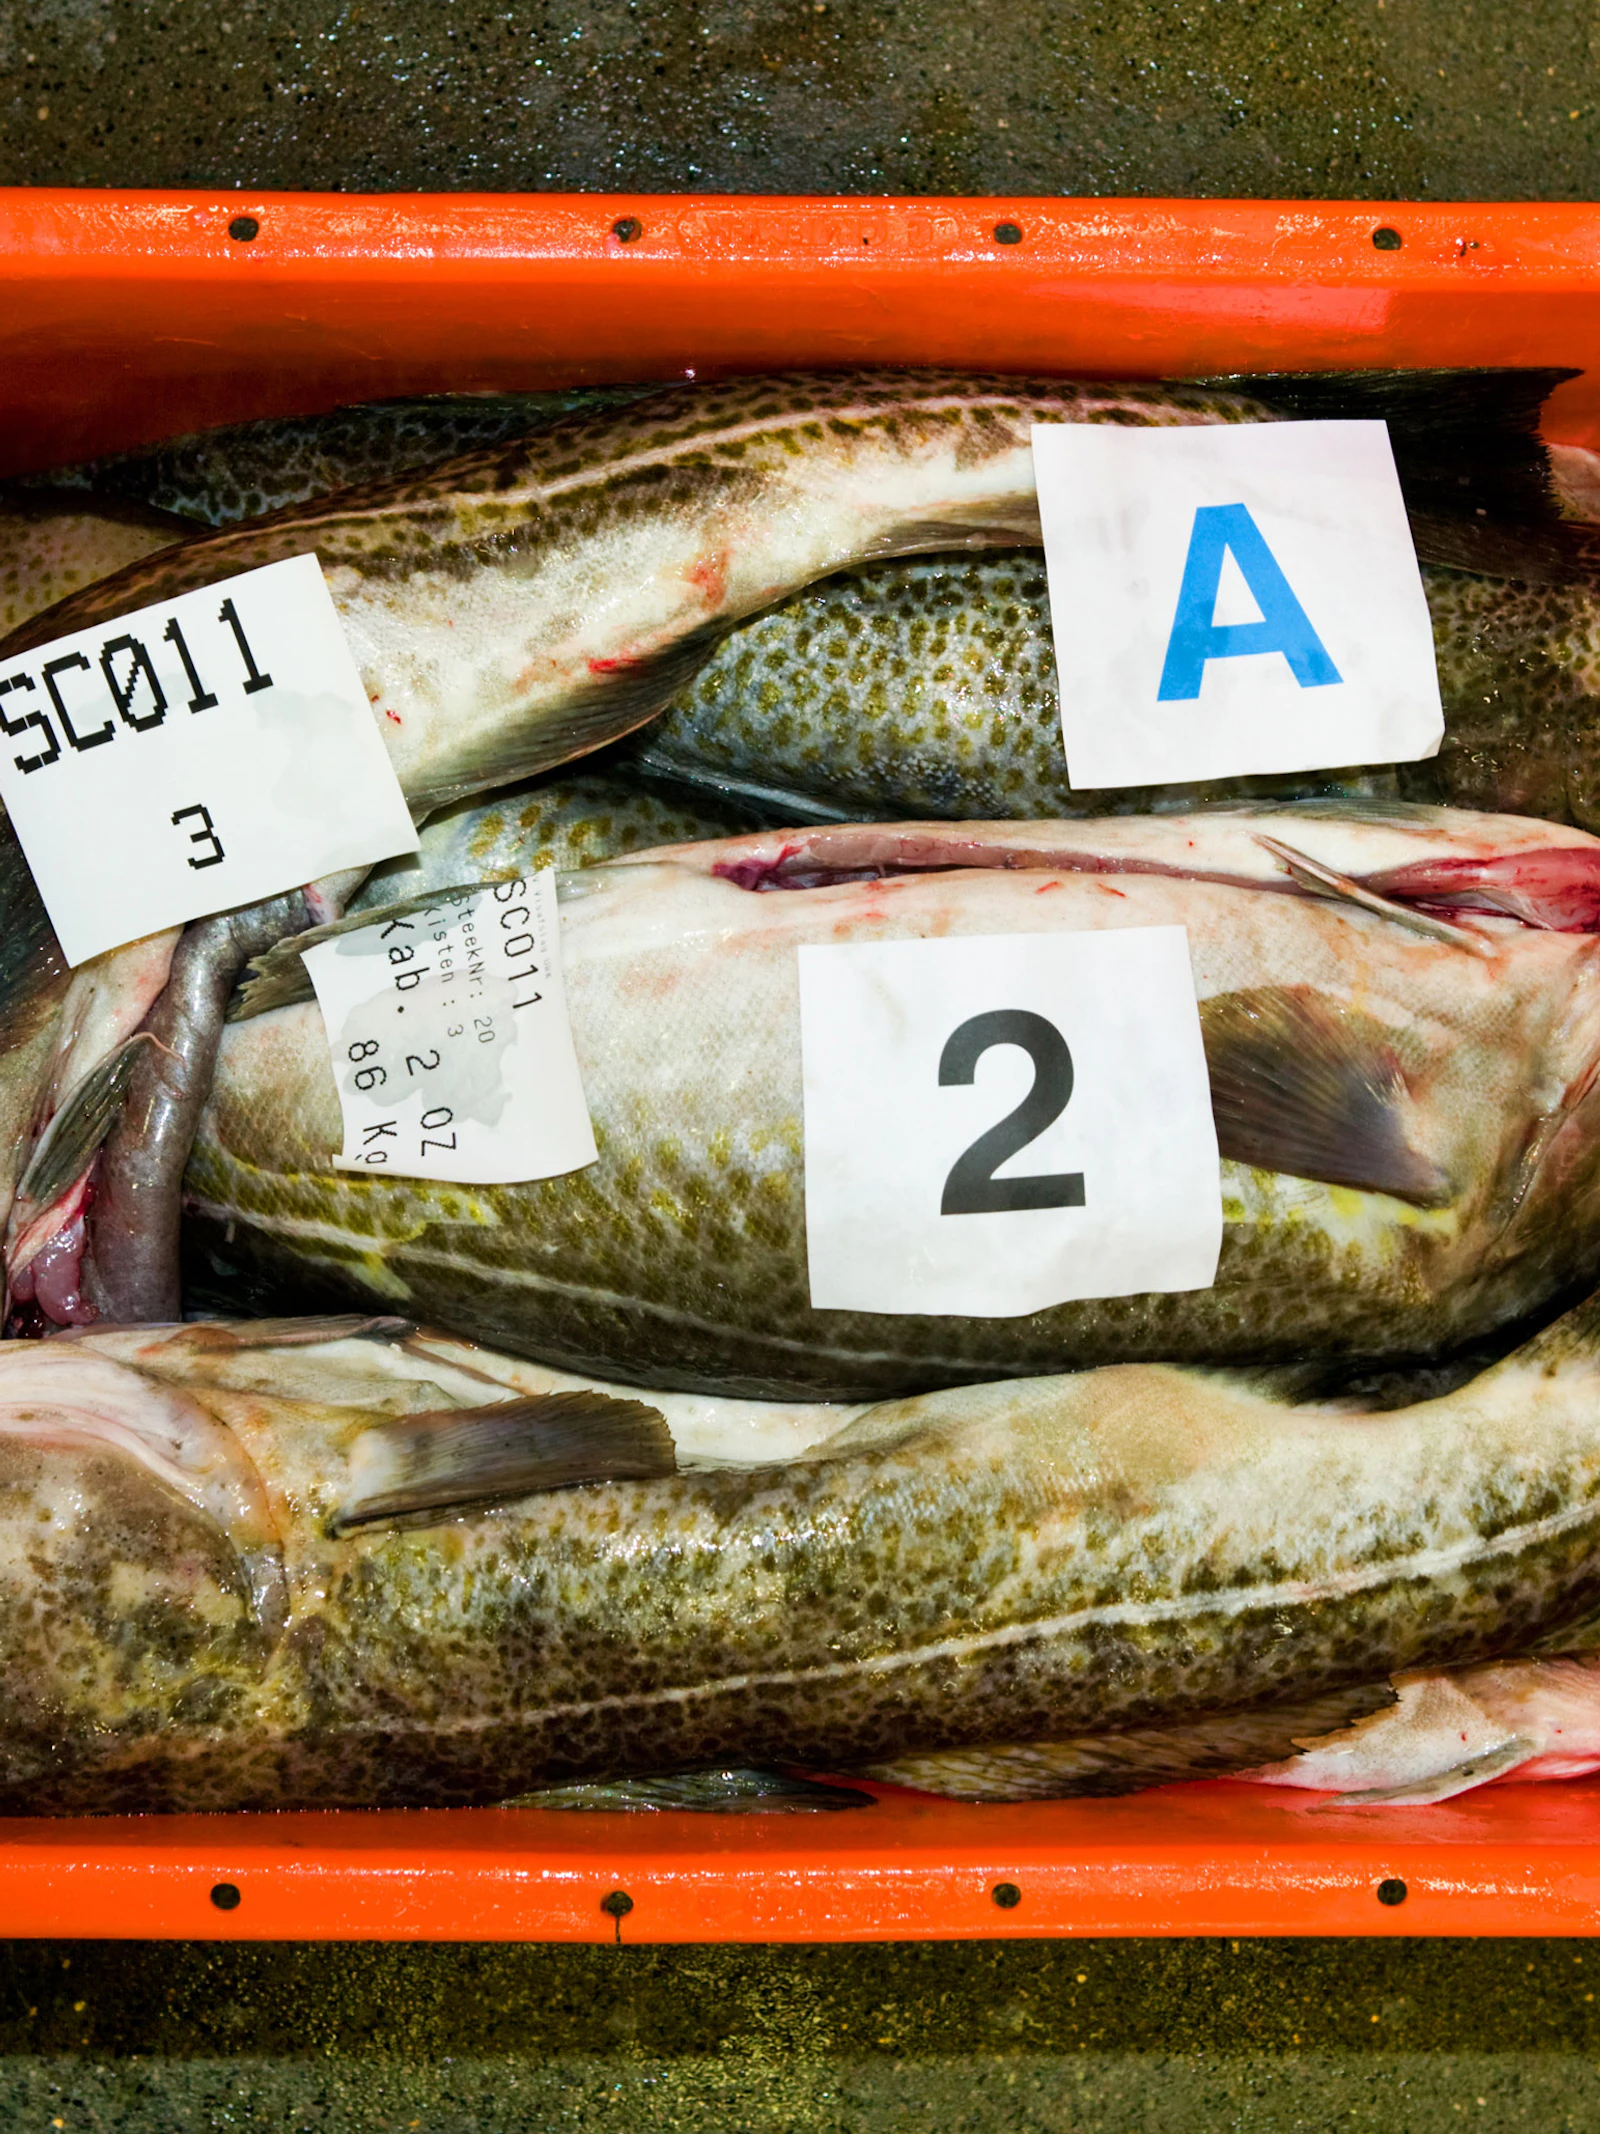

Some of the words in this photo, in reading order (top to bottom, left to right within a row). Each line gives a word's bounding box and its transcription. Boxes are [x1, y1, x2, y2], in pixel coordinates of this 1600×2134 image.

[1157, 503, 1343, 701] A
[171, 804, 225, 870] 3
[447, 1024, 464, 1038] 3
[473, 1017, 495, 1043] 20
[348, 1040, 387, 1090] 86
[406, 1050, 440, 1076] 2
[938, 1008, 1086, 1216] 2
